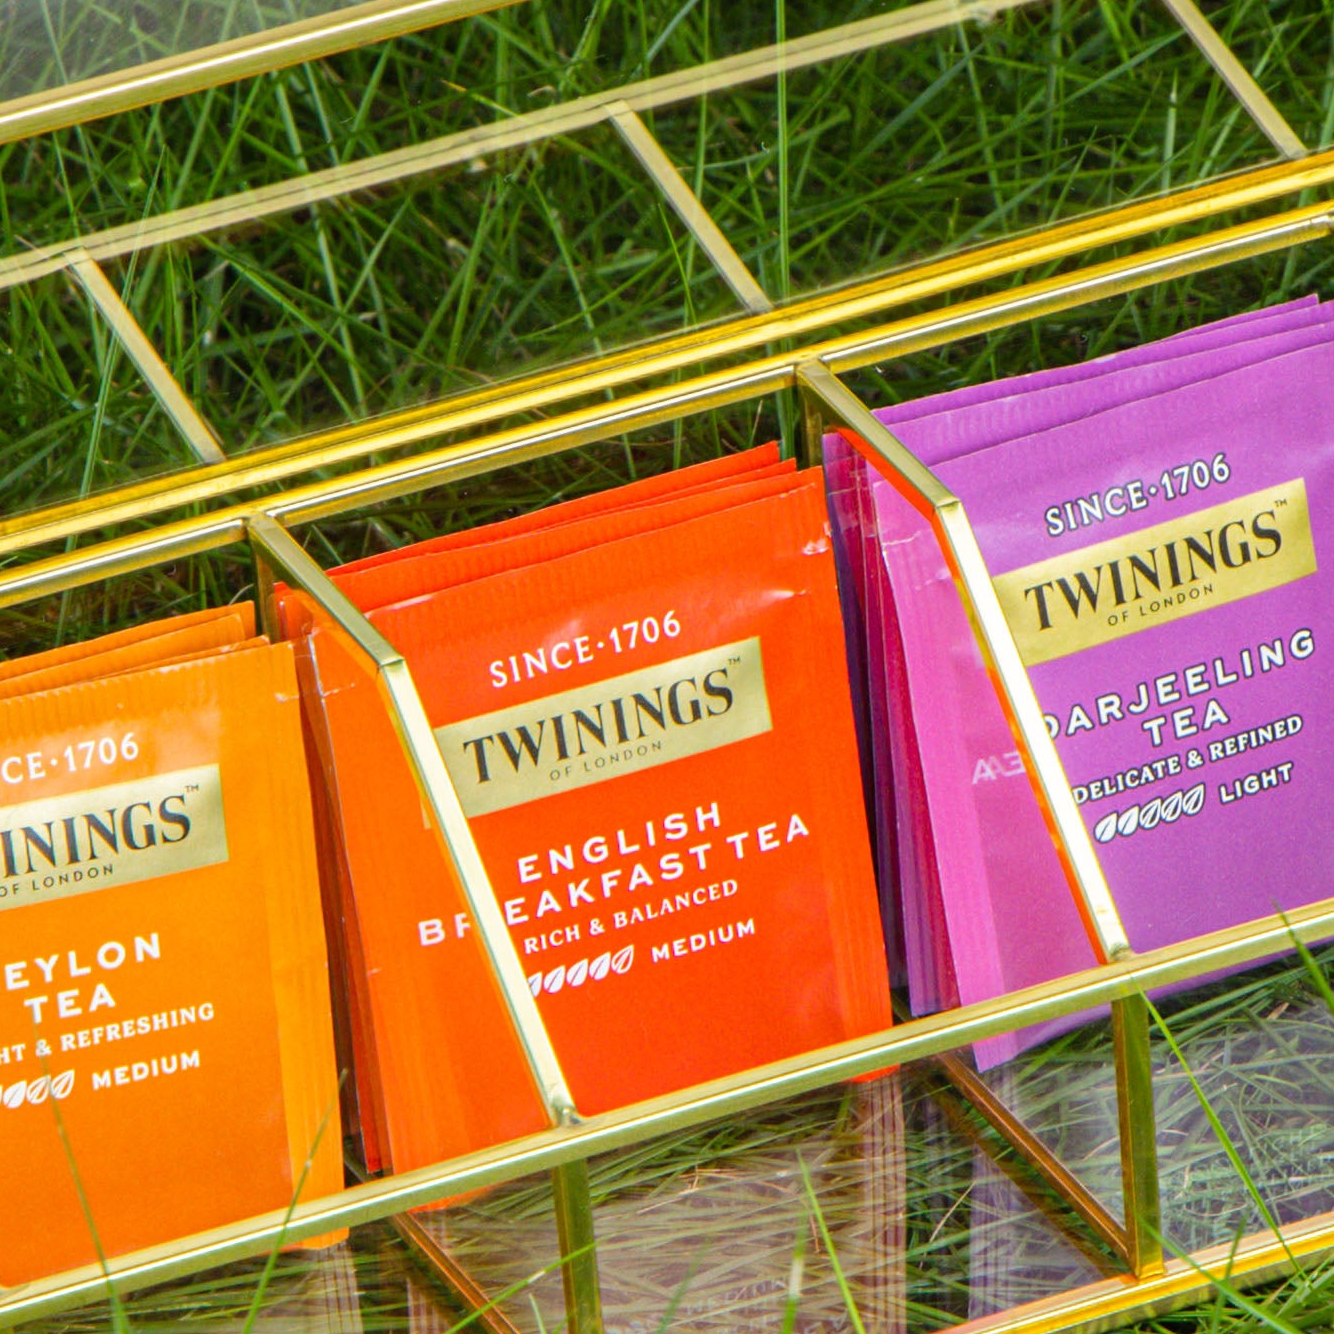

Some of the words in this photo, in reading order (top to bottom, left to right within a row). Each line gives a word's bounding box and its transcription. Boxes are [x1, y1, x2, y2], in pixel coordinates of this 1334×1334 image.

[1107, 611, 1130, 627] OF
[1139, 583, 1214, 617] LONDON
[1142, 699, 1230, 747] TEA
[550, 765, 572, 781] OF
[584, 740, 663, 772] LONDON
[1071, 754, 1182, 806] DELICATE
[1186, 748, 1204, 769] &
[1208, 714, 1304, 763] REFINED
[1219, 762, 1294, 804] LIGHT
[517, 801, 722, 884] ENGLISH
[725, 813, 809, 860] TEA
[32, 863, 114, 891] LONDON
[523, 924, 581, 955] RICH
[589, 917, 605, 935] &
[613, 878, 738, 930] BALANCED
[650, 918, 756, 963] MEDIUM
[24, 983, 116, 1024] TEA
[35, 1039, 52, 1057] &
[60, 1002, 214, 1052] REFRESHING
[91, 1050, 200, 1090] MEDIUM
